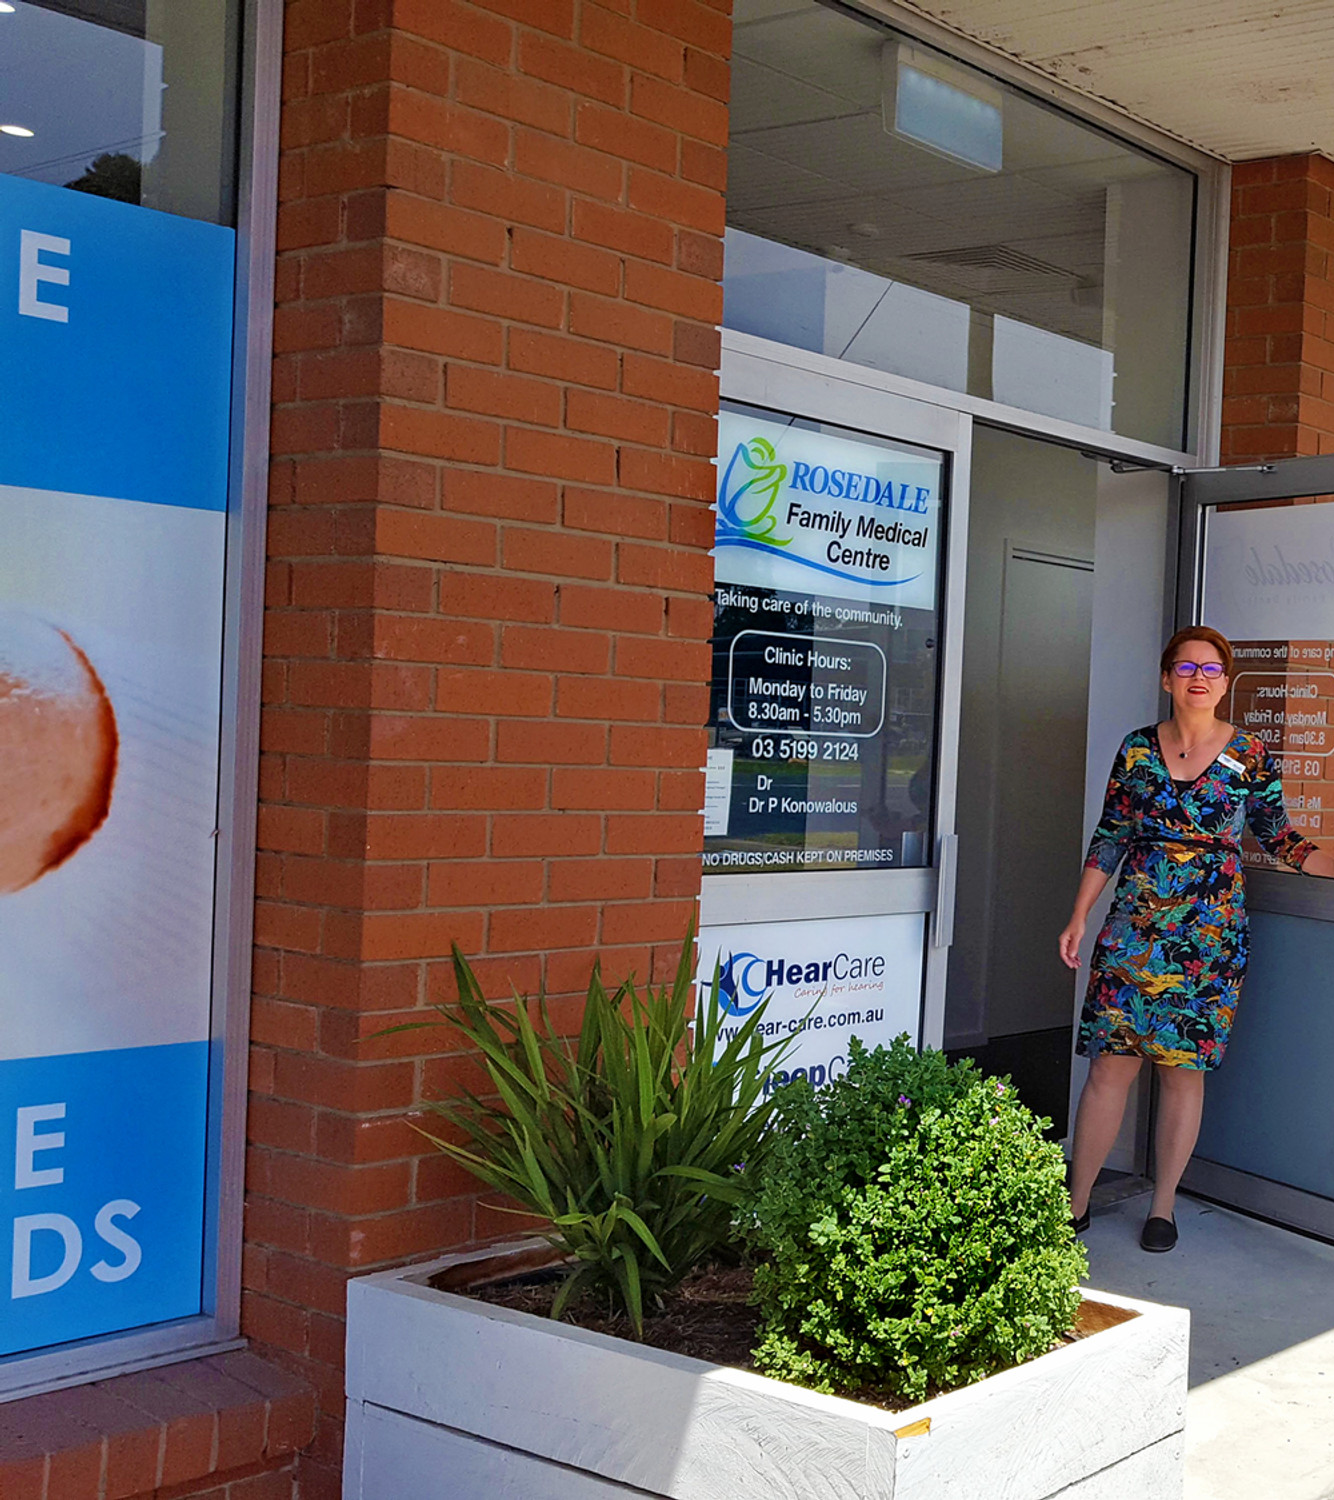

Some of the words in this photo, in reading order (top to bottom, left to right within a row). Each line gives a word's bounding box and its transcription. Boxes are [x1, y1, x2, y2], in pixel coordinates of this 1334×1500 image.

[19, 229, 71, 323] E
[788, 461, 931, 515] ROSEDALE
[786, 502, 852, 538] Family
[856, 515, 929, 548] Medical
[826, 541, 891, 571] Centre
[714, 589, 758, 613] Taking
[763, 597, 791, 614] care
[794, 600, 811, 616] of
[812, 602, 833, 618] the
[835, 607, 904, 630] community.
[764, 646, 803, 666] Clinic
[807, 651, 851, 670] Hours:
[749, 678, 806, 700] Monday
[810, 683, 823, 698] to
[827, 684, 867, 705] Friday
[748, 702, 799, 722] 8.30am
[813, 709, 862, 728] 5.30pm
[752, 739, 773, 758] 03
[779, 739, 818, 759] 5199
[823, 742, 859, 761] 2124
[757, 774, 773, 791] Dr
[748, 797, 764, 813] Dr
[767, 798, 777, 812] P
[781, 797, 858, 814] Konowalous
[702, 853, 720, 867] NO
[796, 850, 823, 863] KEPT
[826, 850, 842, 862] ON
[844, 849, 894, 863] PREMISES
[765, 953, 885, 988] HearCare
[794, 986, 827, 999] Caring
[830, 984, 845, 997] for
[848, 981, 884, 992] hearing
[14, 1102, 66, 1190] E
[11, 1198, 143, 1300] DS
